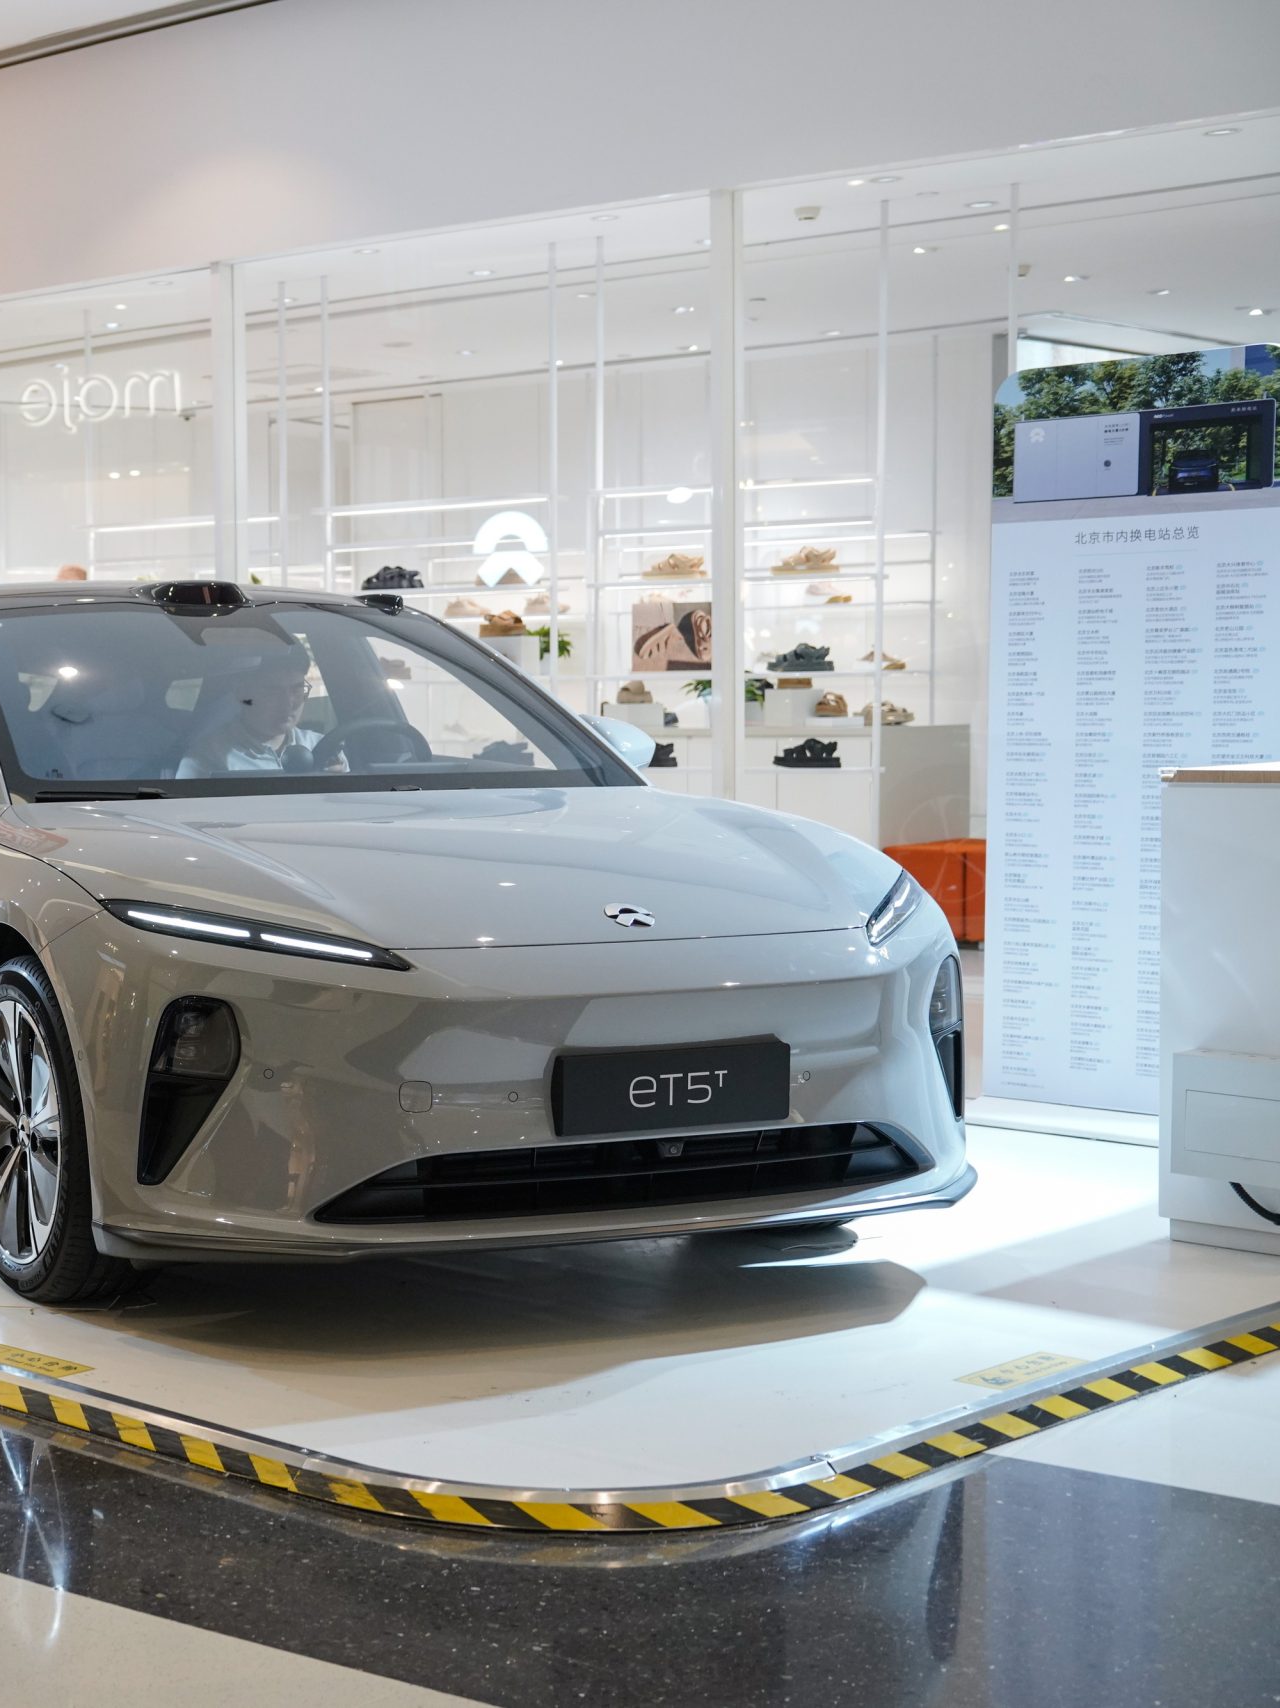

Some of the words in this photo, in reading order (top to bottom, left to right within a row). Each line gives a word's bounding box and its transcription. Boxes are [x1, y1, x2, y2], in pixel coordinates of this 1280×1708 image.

[1074, 525, 1200, 545] 北京市内换电站总览
